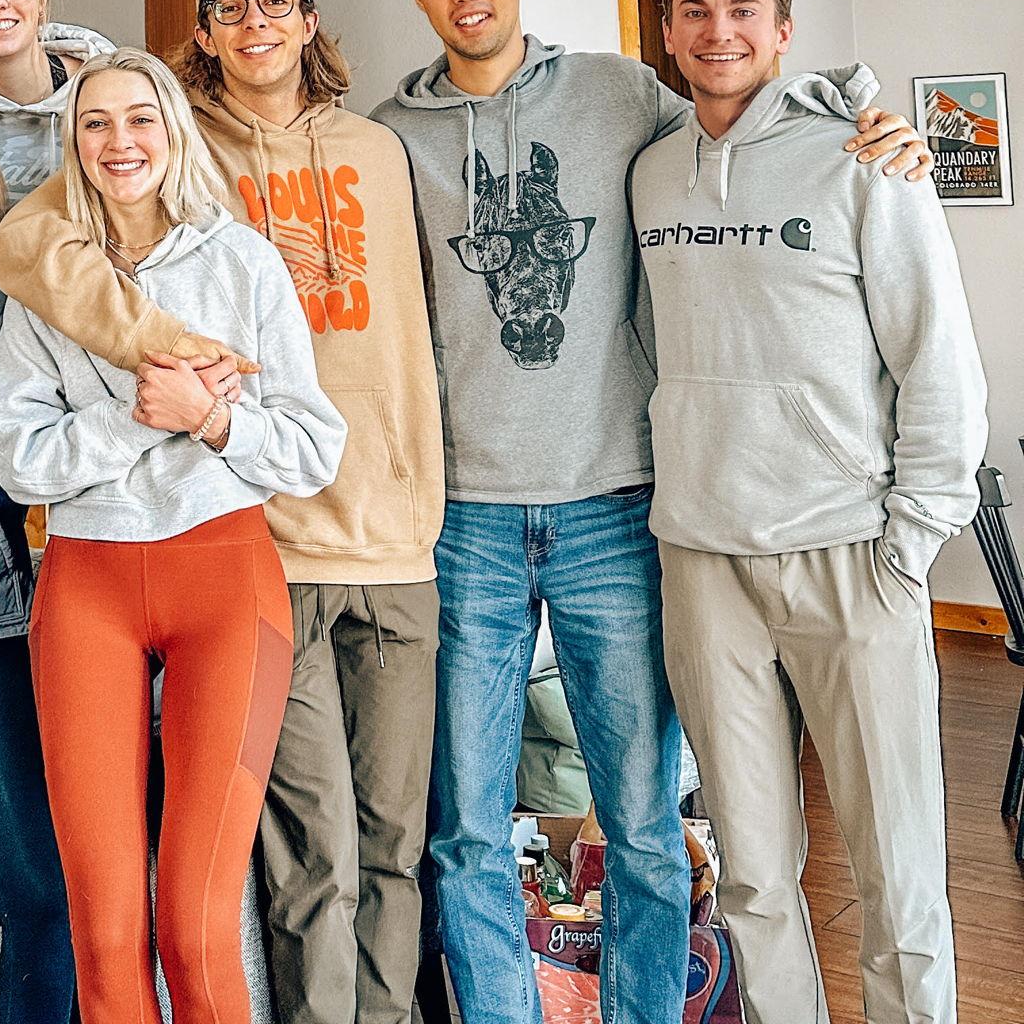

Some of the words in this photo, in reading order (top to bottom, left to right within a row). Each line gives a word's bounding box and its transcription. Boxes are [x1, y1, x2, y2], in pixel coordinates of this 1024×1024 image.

[933, 150, 996, 167] QUANDARY
[933, 167, 962, 182] PEAK
[238, 165, 364, 228] LOUIS
[311, 222, 367, 266] THE
[640, 222, 774, 248] carhartt
